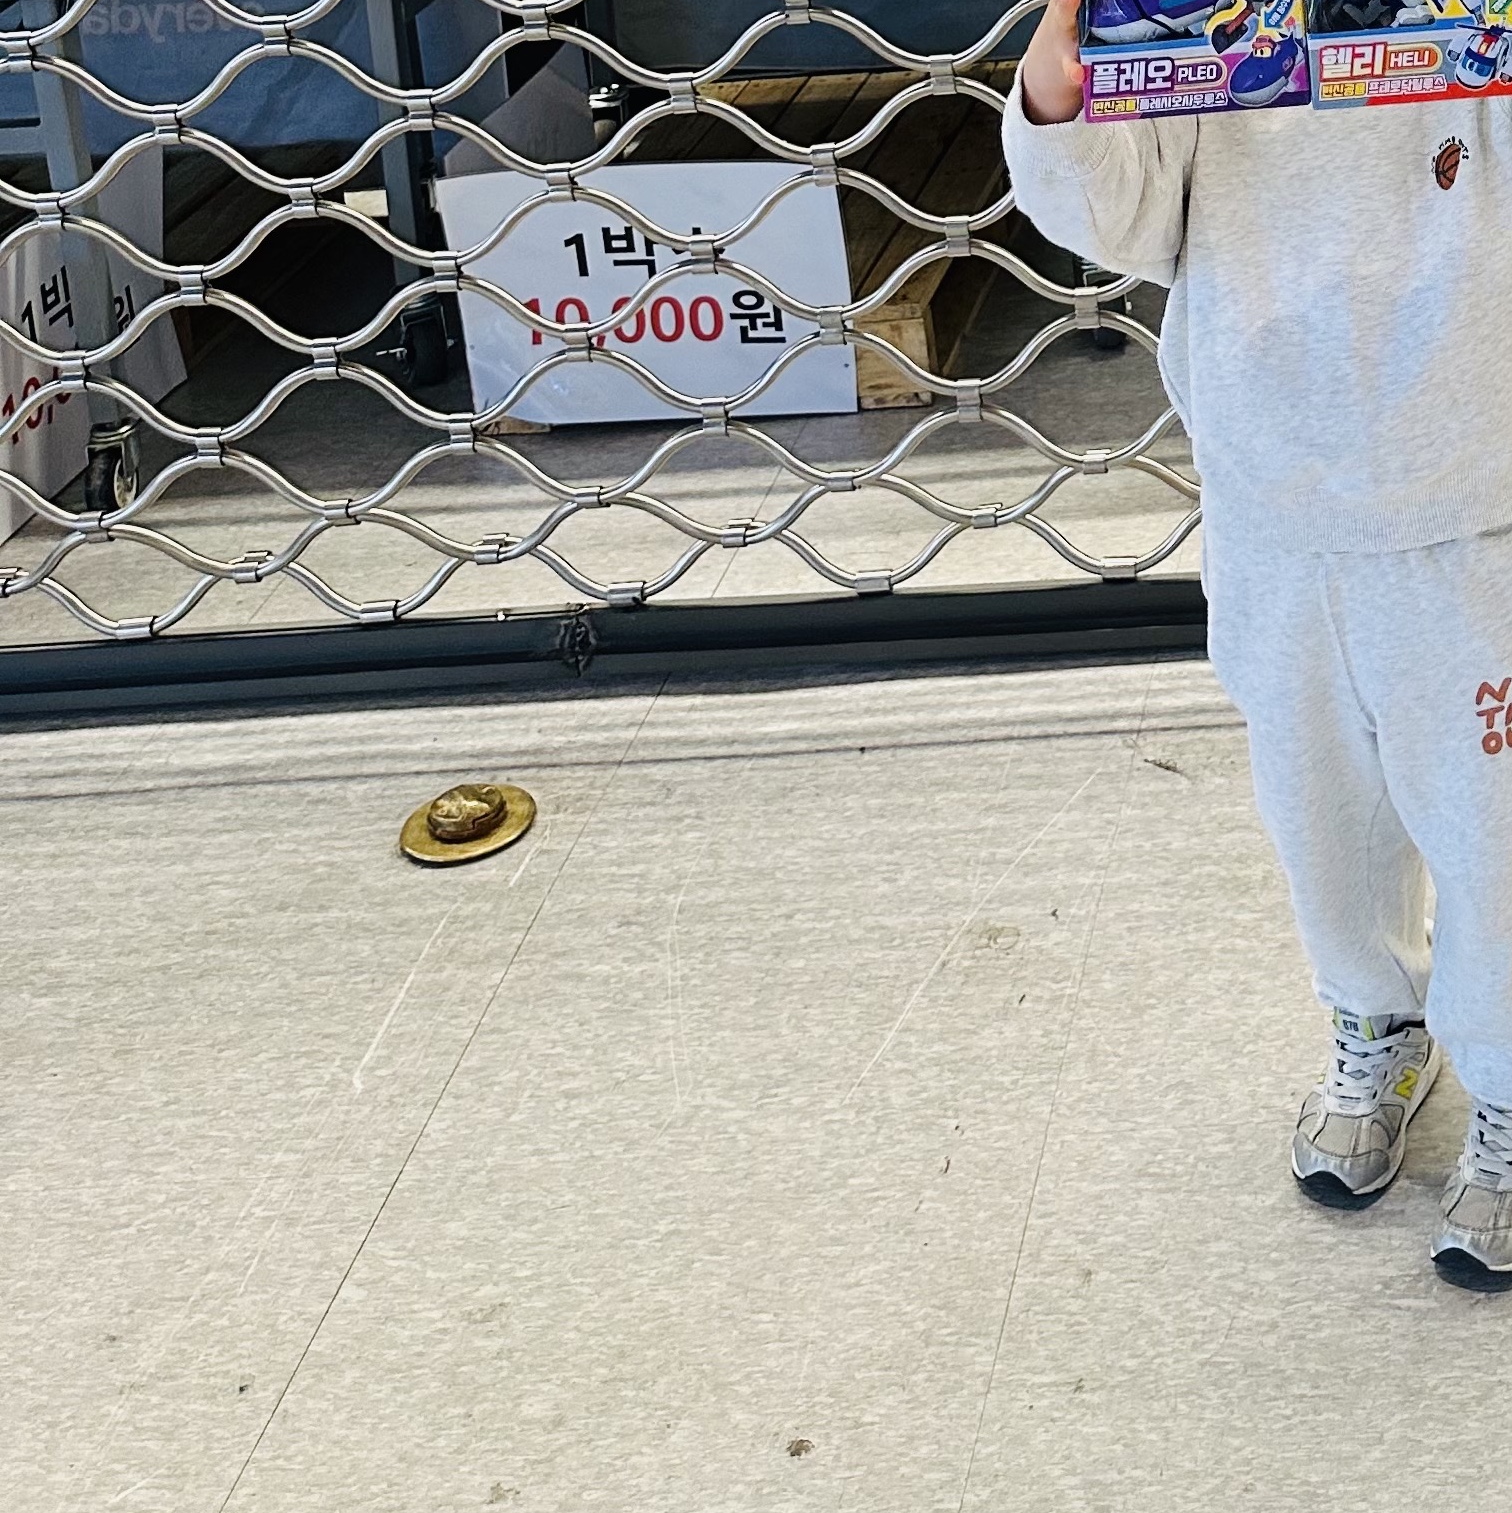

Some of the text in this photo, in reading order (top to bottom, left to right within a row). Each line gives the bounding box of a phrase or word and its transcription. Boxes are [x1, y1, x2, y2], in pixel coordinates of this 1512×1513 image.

[1092, 58, 1218, 94] 플레오 PLEO
[1320, 44, 1430, 80] 헬리 HELI
